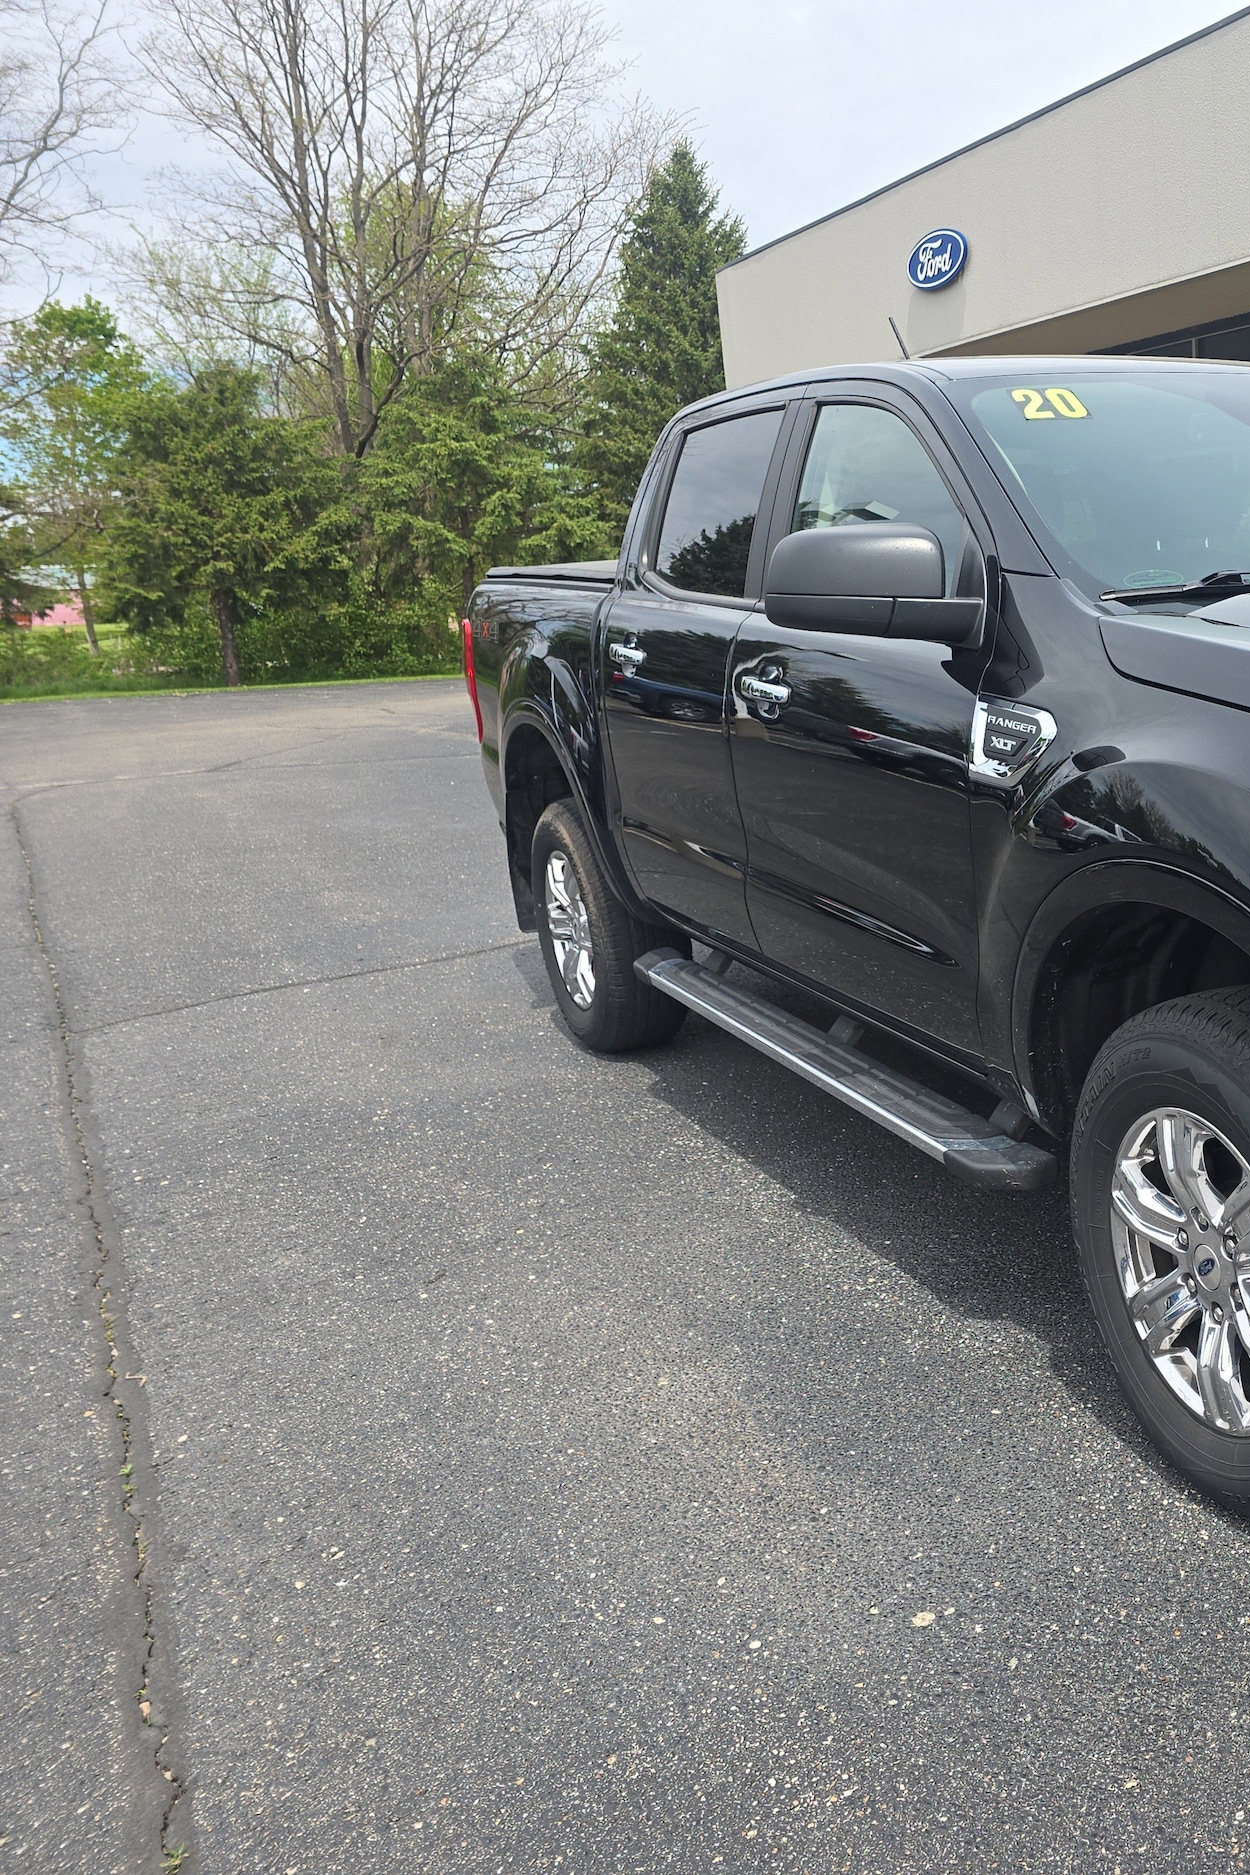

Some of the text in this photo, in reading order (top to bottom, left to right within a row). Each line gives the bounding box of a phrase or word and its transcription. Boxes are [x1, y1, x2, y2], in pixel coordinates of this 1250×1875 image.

[917, 239, 952, 281] Ford
[1011, 388, 1088, 419] 20
[987, 715, 1037, 734] RANGER
[990, 736, 1016, 751] XLT
